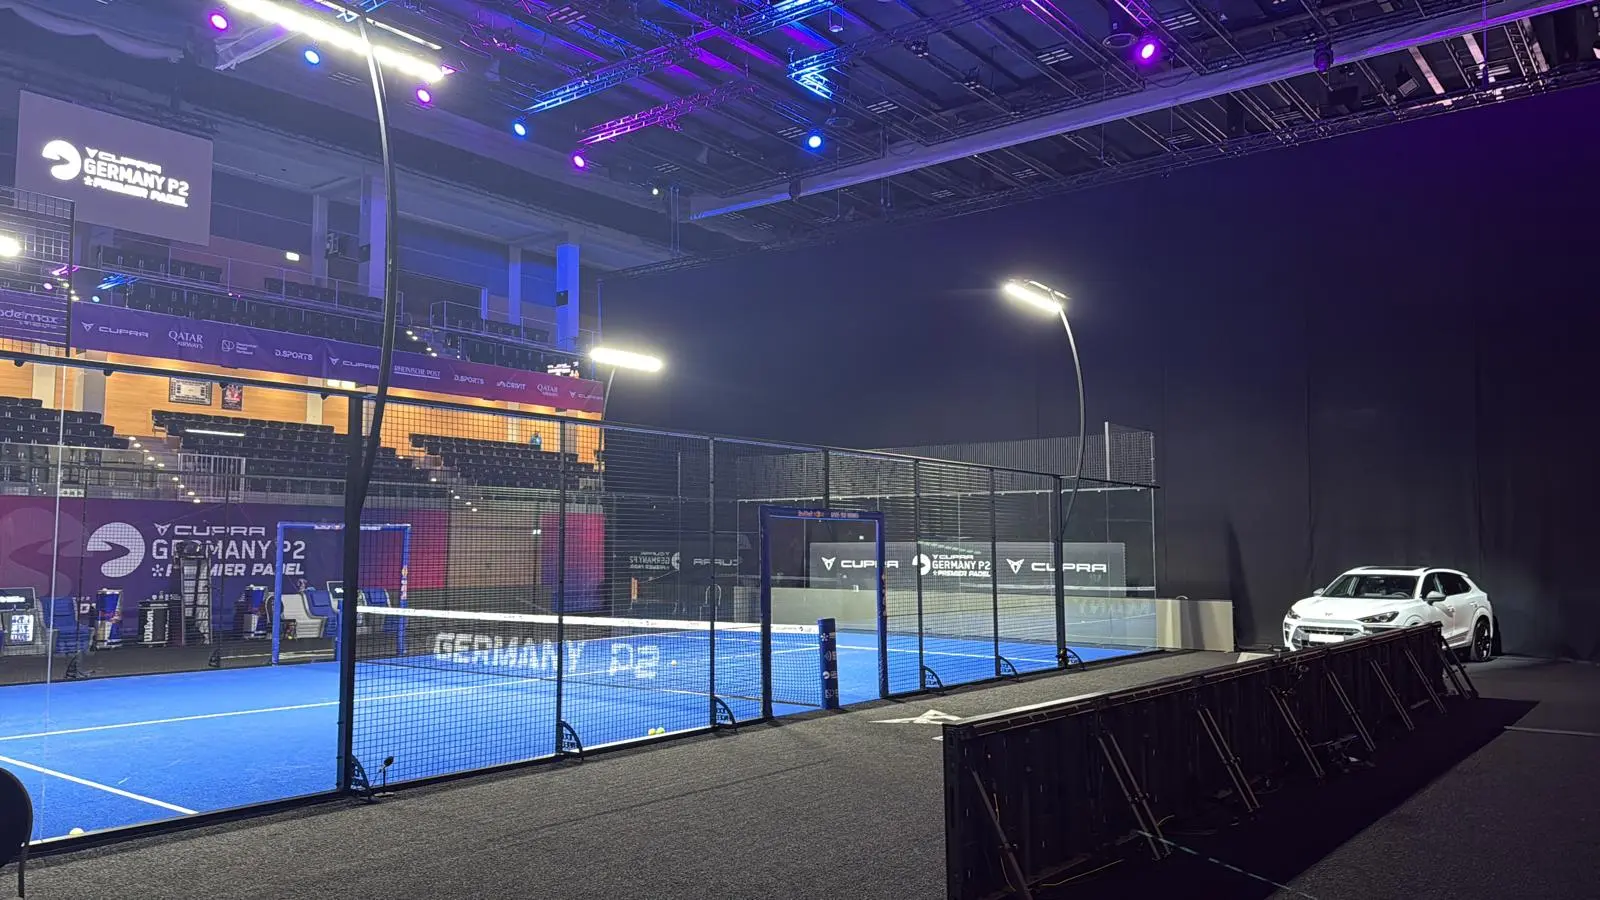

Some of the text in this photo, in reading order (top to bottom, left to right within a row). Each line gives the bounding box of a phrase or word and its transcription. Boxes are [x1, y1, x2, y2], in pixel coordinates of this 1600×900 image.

[84, 159, 190, 197] GERMANY P2
[98, 326, 149, 338] CUPRA
[168, 330, 204, 344] QATAR
[274, 349, 313, 361] D.SPORTS
[174, 525, 266, 537] CUPRA
[152, 539, 271, 560] GMANY
[840, 560, 899, 569] CUPA
[932, 560, 991, 571] GERMANY P2
[1031, 562, 1107, 573] CUPRA
[143, 610, 154, 642] Wilson
[433, 631, 586, 672] GERMANY
